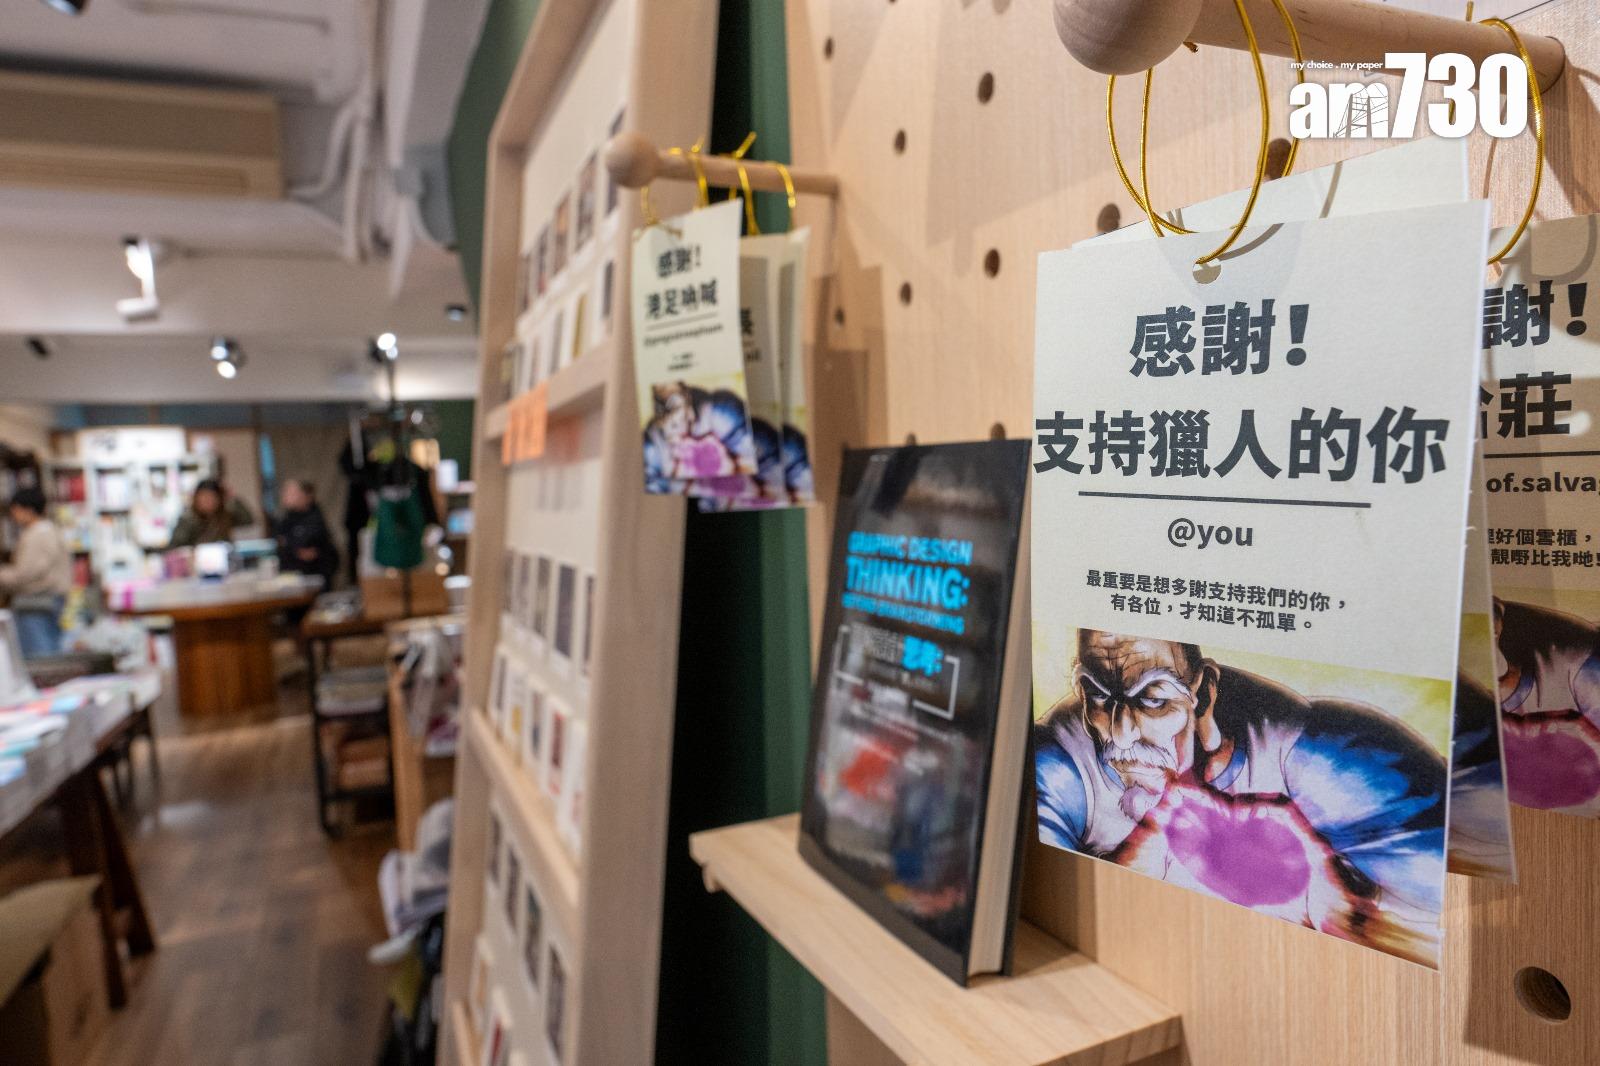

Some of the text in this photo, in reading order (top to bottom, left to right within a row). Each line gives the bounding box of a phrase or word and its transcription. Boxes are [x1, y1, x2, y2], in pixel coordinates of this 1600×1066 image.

[1129, 298, 1310, 378] 感謝！
[1033, 405, 1450, 485] 支持獵人的你
[1486, 472, 1600, 496] of.salva
[908, 535, 973, 566] DESIGN
[1167, 517, 1254, 550] @you
[845, 554, 970, 610] THINKING:
[1086, 569, 1346, 613] 最重要是想多謝支持我們的你，
[1110, 593, 1312, 632] 有各位，才知道不孤單。
